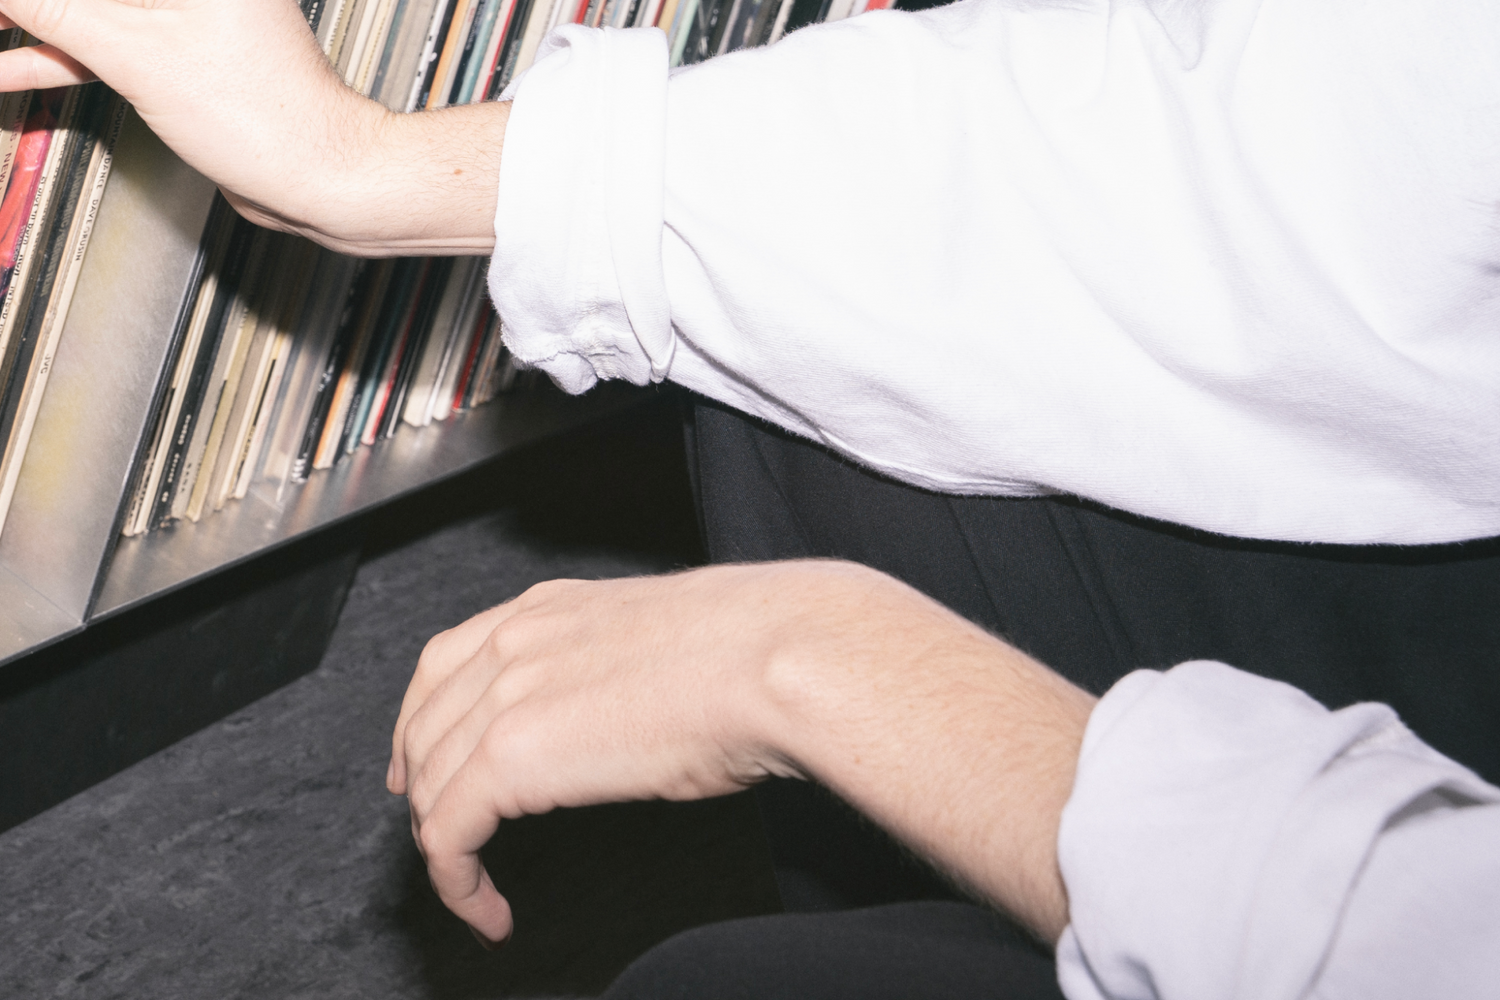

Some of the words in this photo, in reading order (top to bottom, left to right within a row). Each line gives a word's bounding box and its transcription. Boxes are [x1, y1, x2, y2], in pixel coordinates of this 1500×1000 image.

[105, 102, 127, 154] MOUNTAIN
[95, 157, 111, 189] DANCE
[85, 199, 99, 223] DAVE
[74, 226, 91, 261] GRUSIN
[39, 354, 52, 373] JVC
